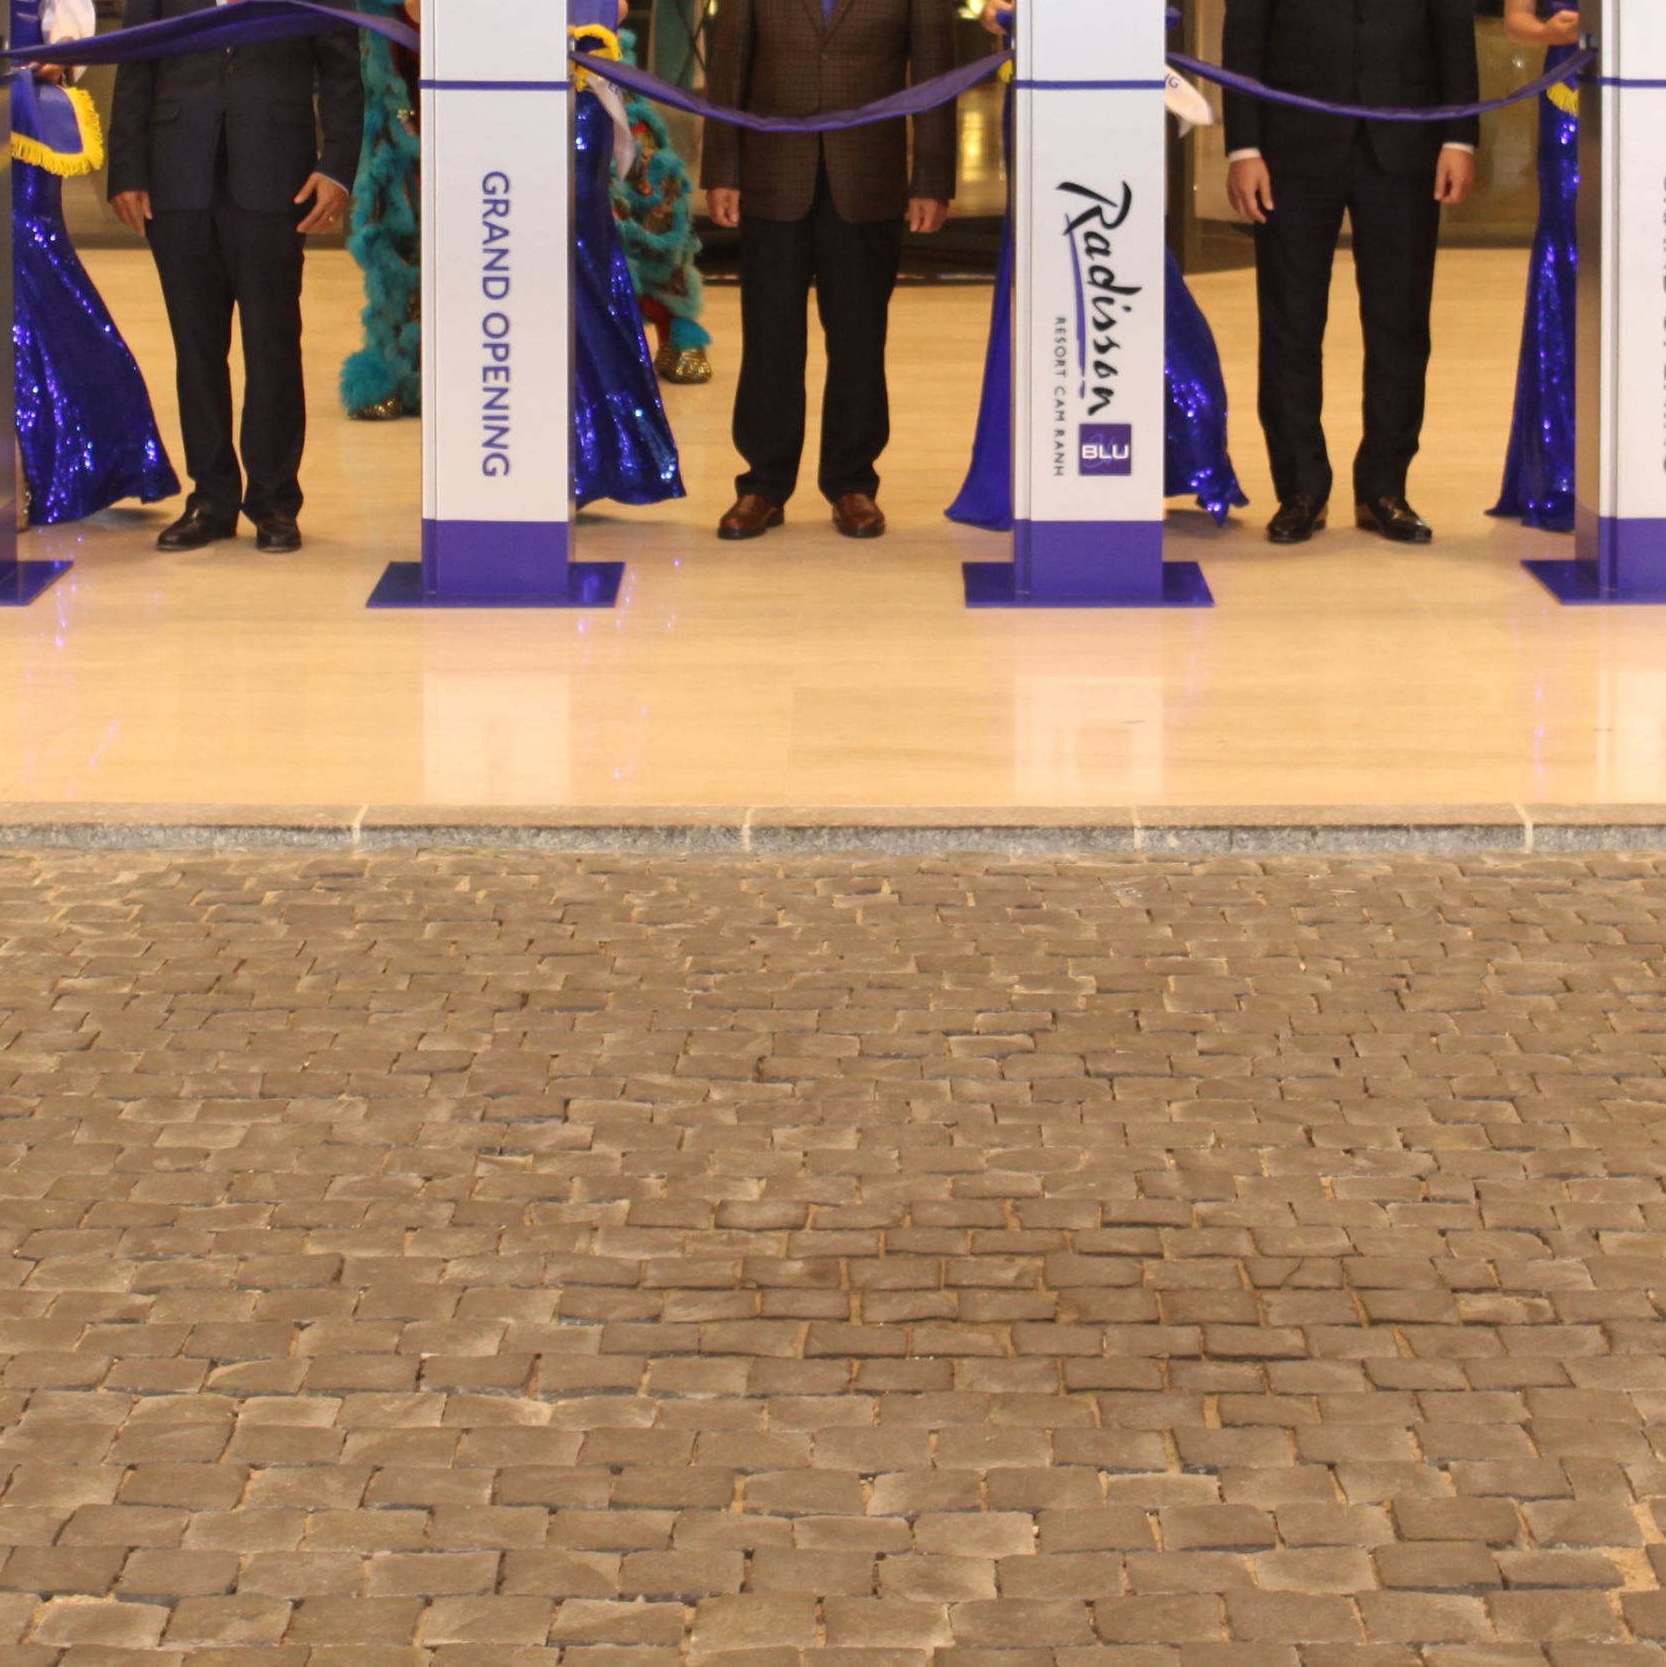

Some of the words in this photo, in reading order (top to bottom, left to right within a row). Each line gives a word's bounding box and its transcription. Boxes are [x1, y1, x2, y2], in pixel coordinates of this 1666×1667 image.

[481, 171, 510, 301] GRAND
[1054, 180, 1143, 416] Radisson
[1054, 316, 1066, 378] RESORT
[481, 312, 511, 477] OPENING
[1053, 386, 1066, 422] CAM
[1053, 428, 1065, 477] RANH
[1081, 444, 1130, 460] BLU
